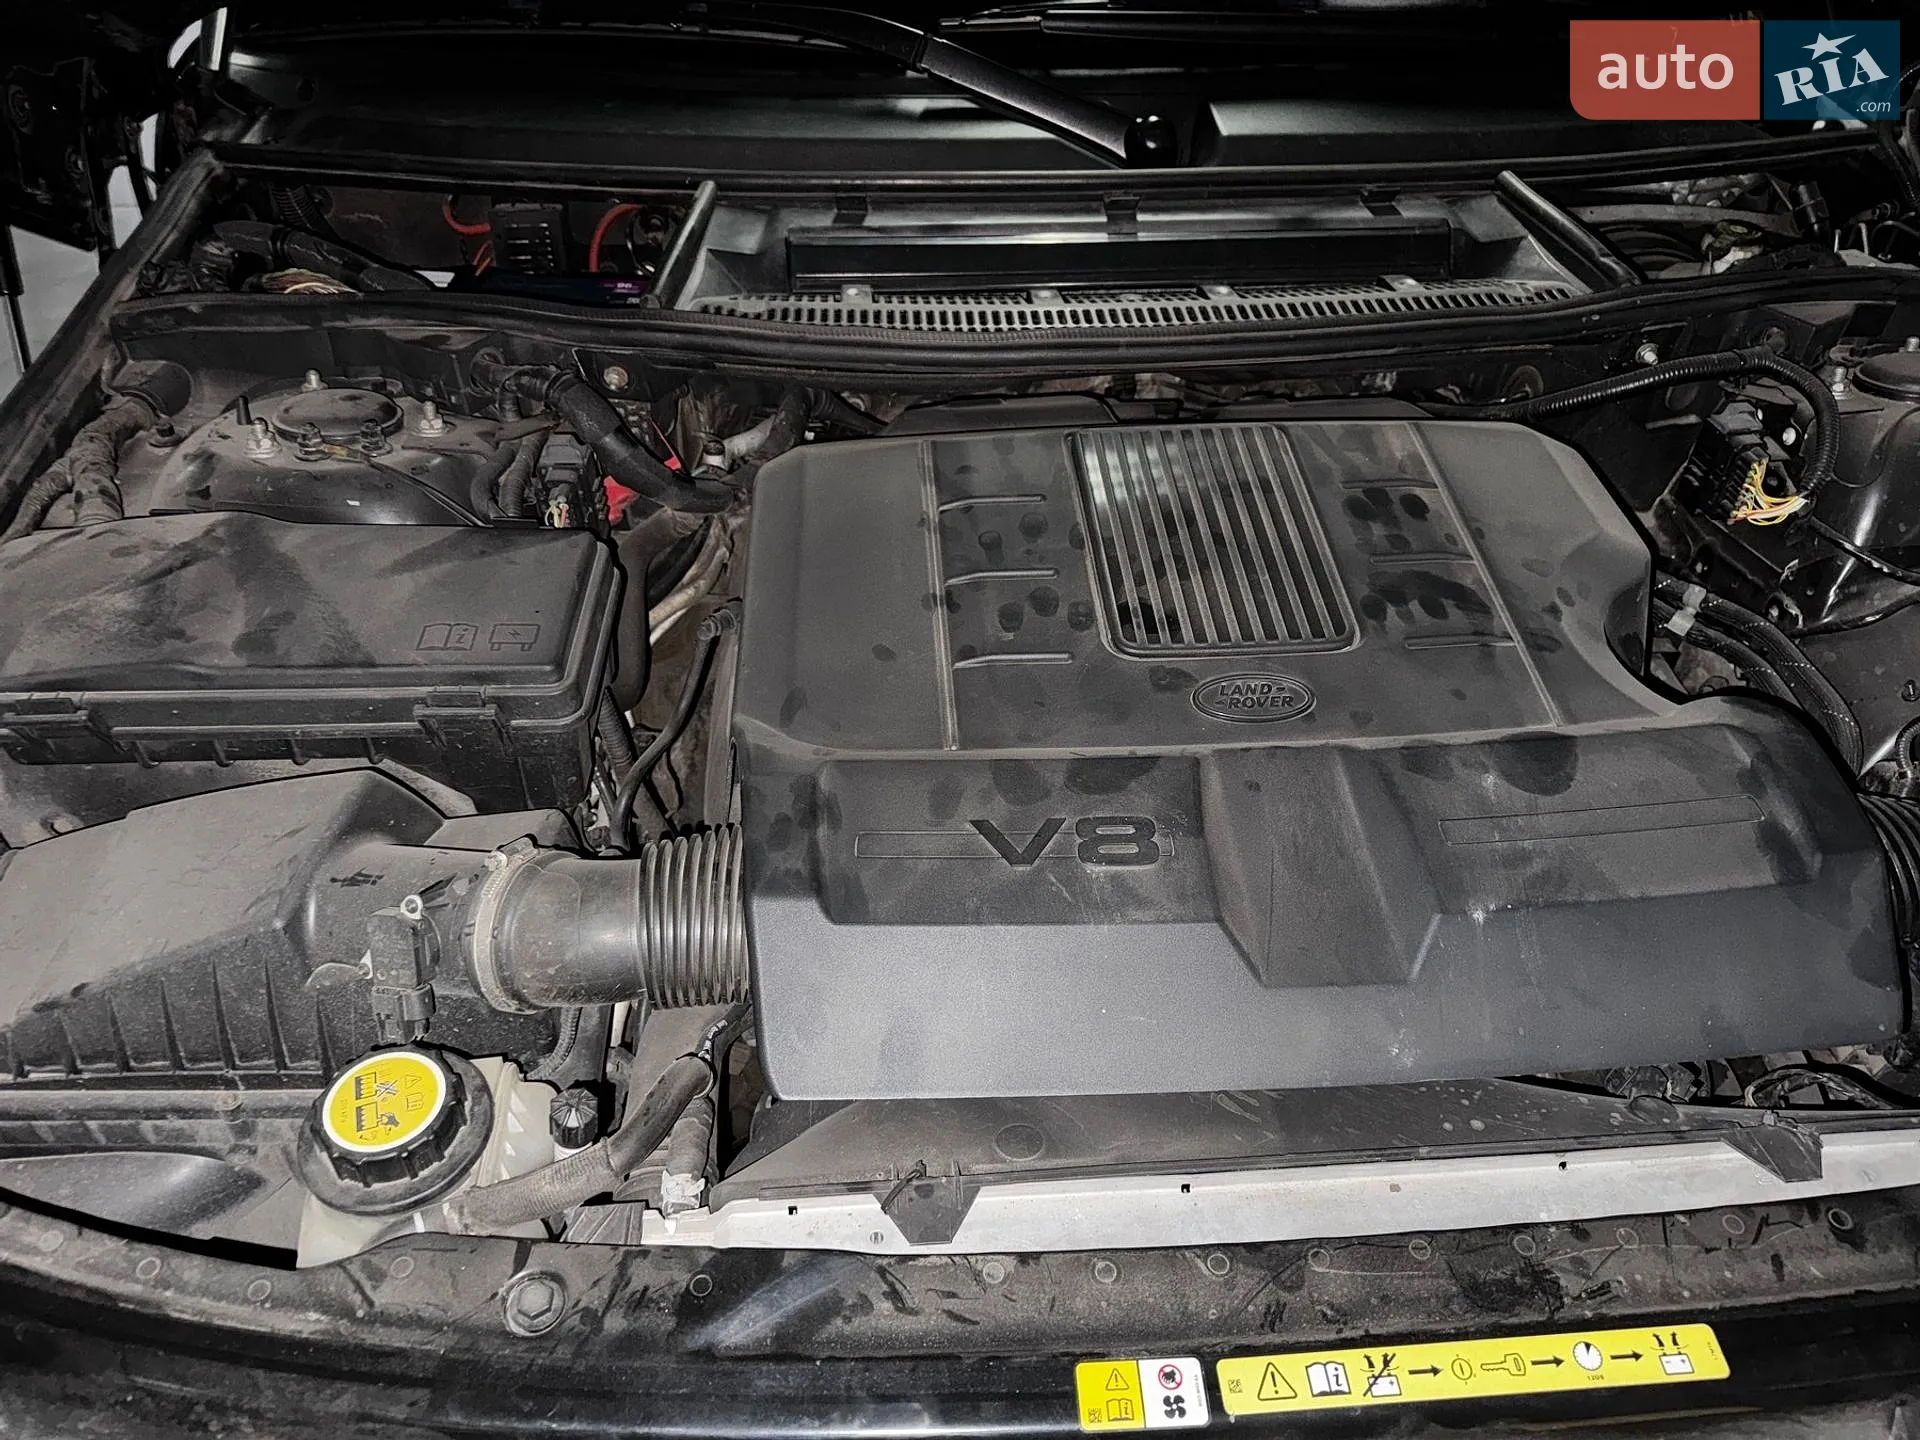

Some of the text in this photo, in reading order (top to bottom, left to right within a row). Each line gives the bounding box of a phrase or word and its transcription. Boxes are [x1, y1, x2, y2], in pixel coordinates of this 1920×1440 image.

[1219, 682, 1273, 696] LAND
[1227, 695, 1295, 709] ROVER
[969, 816, 1160, 866] V8
